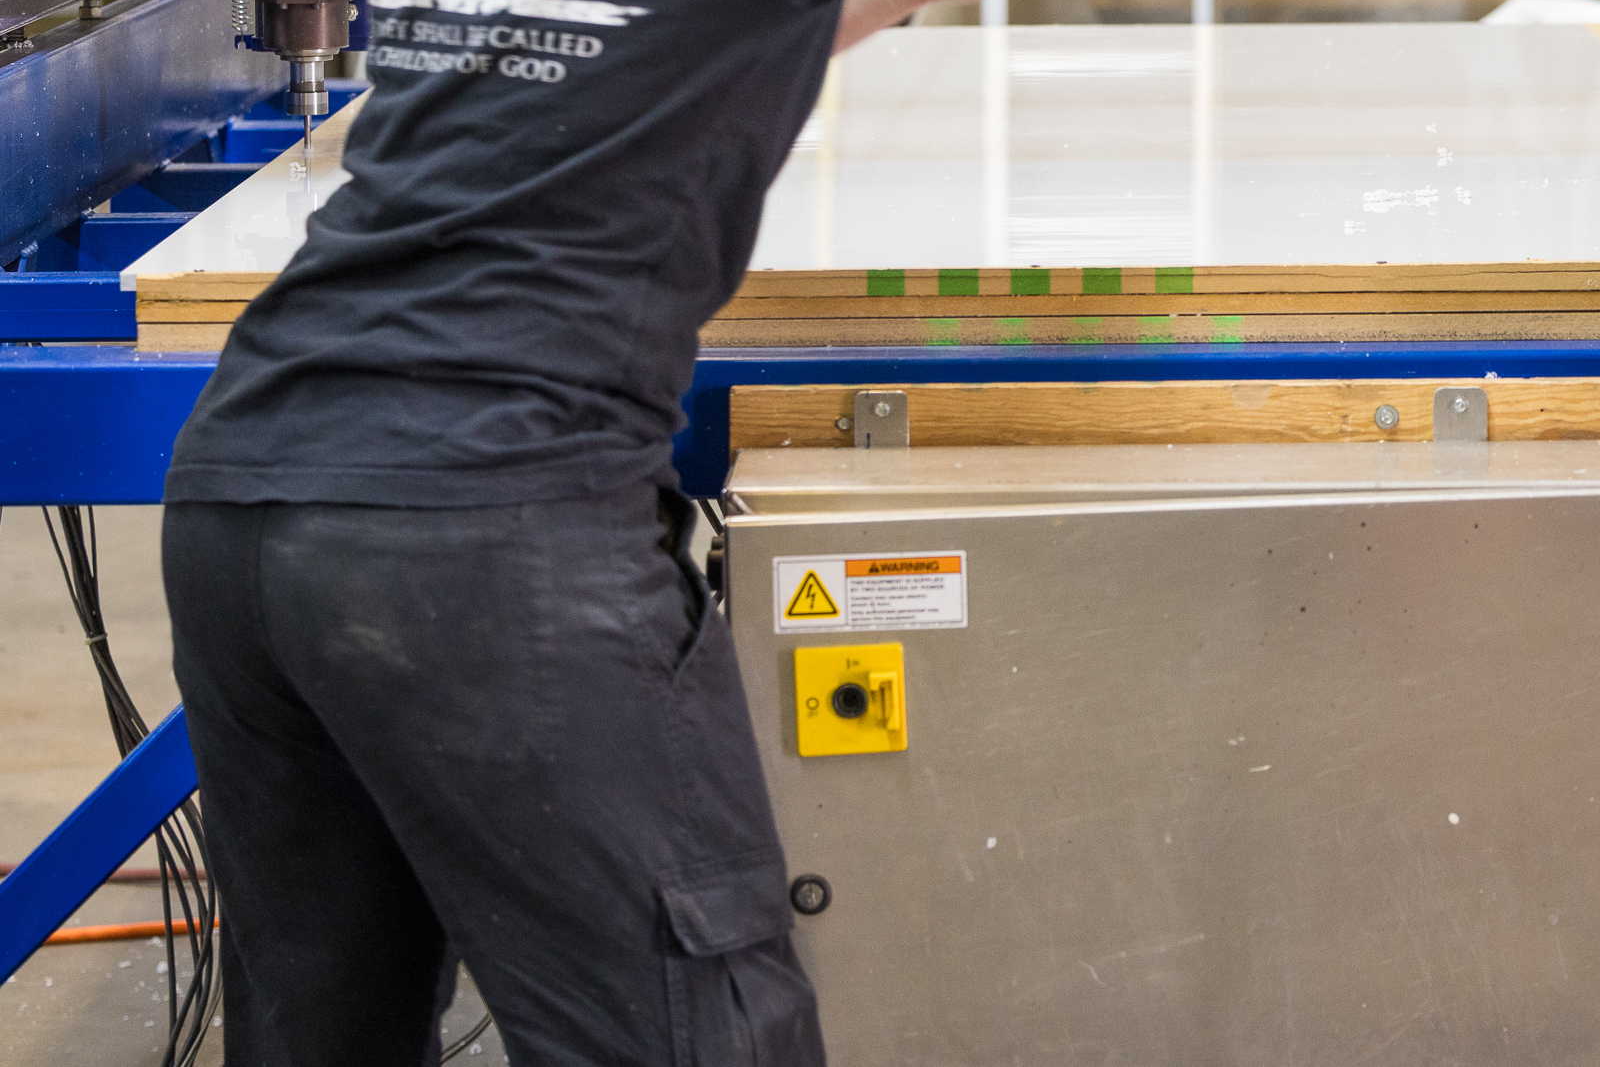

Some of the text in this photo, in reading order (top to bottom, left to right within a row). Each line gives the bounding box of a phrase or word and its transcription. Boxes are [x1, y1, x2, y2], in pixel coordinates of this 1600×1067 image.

[488, 25, 604, 58] CALLED
[456, 51, 493, 73] OF
[499, 54, 567, 83] GOD
[880, 561, 940, 572] WARNING
